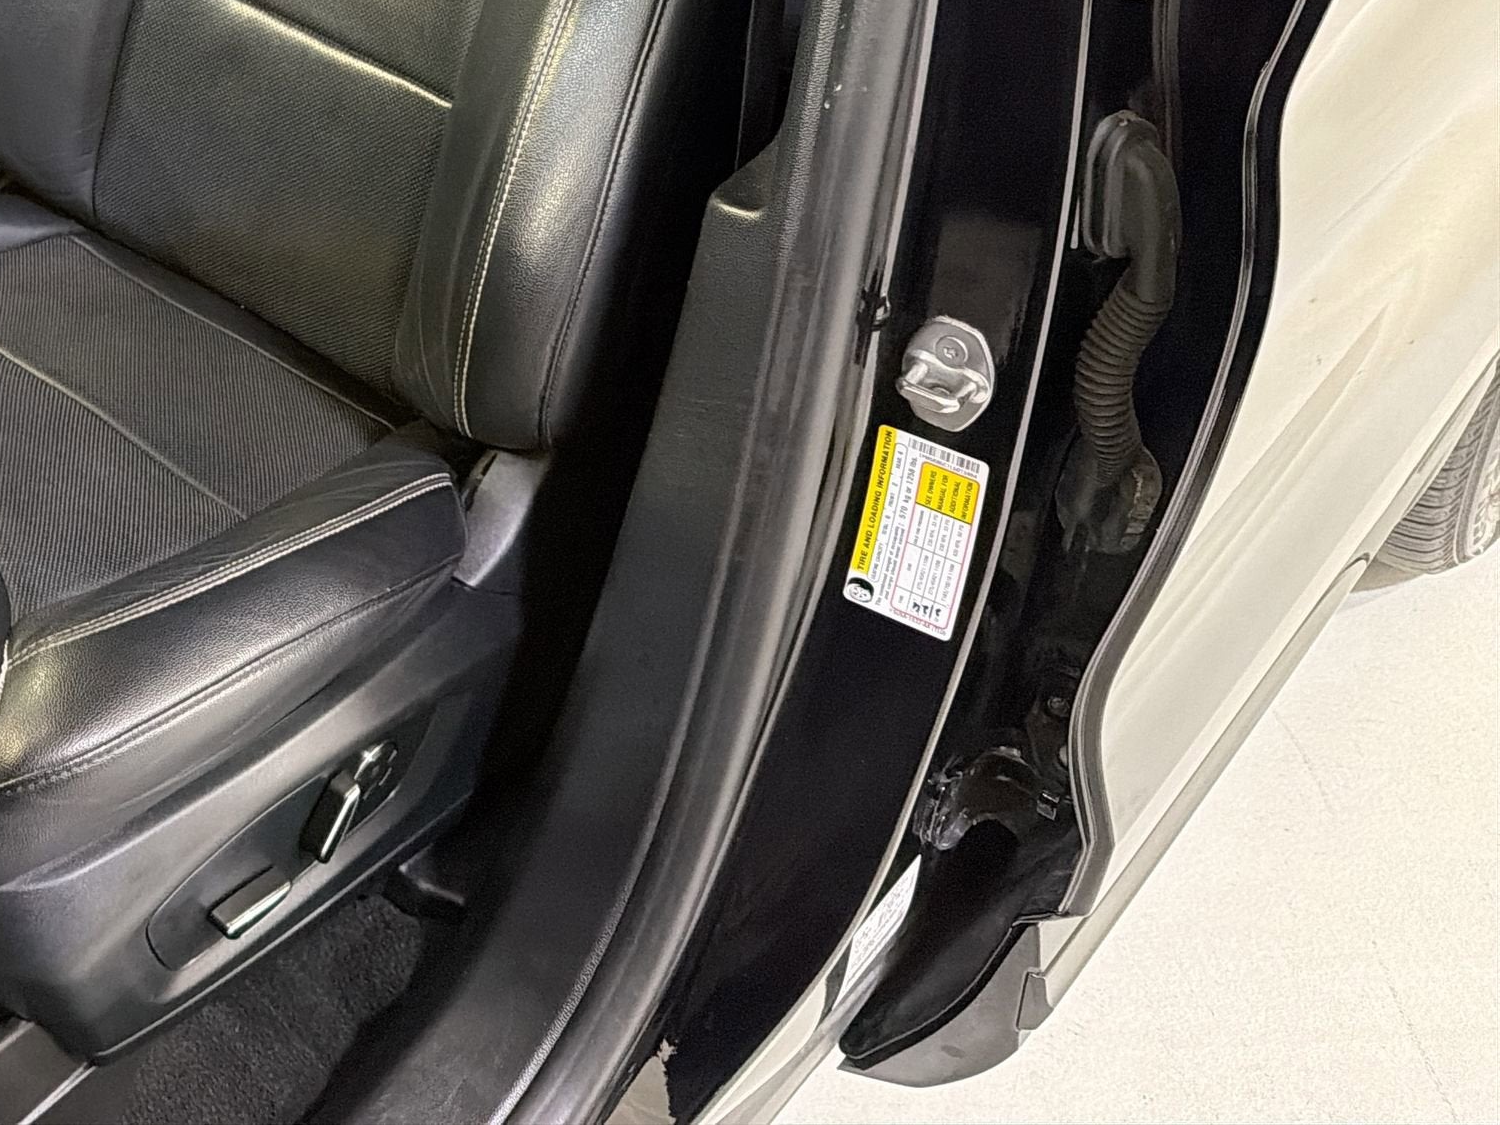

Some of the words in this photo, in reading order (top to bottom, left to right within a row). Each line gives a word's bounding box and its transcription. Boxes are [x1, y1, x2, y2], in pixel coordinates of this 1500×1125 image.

[873, 429, 895, 489] INFORMATION
[866, 488, 882, 528] LOADING
[862, 528, 873, 549] AND
[856, 547, 868, 571] TIRE
